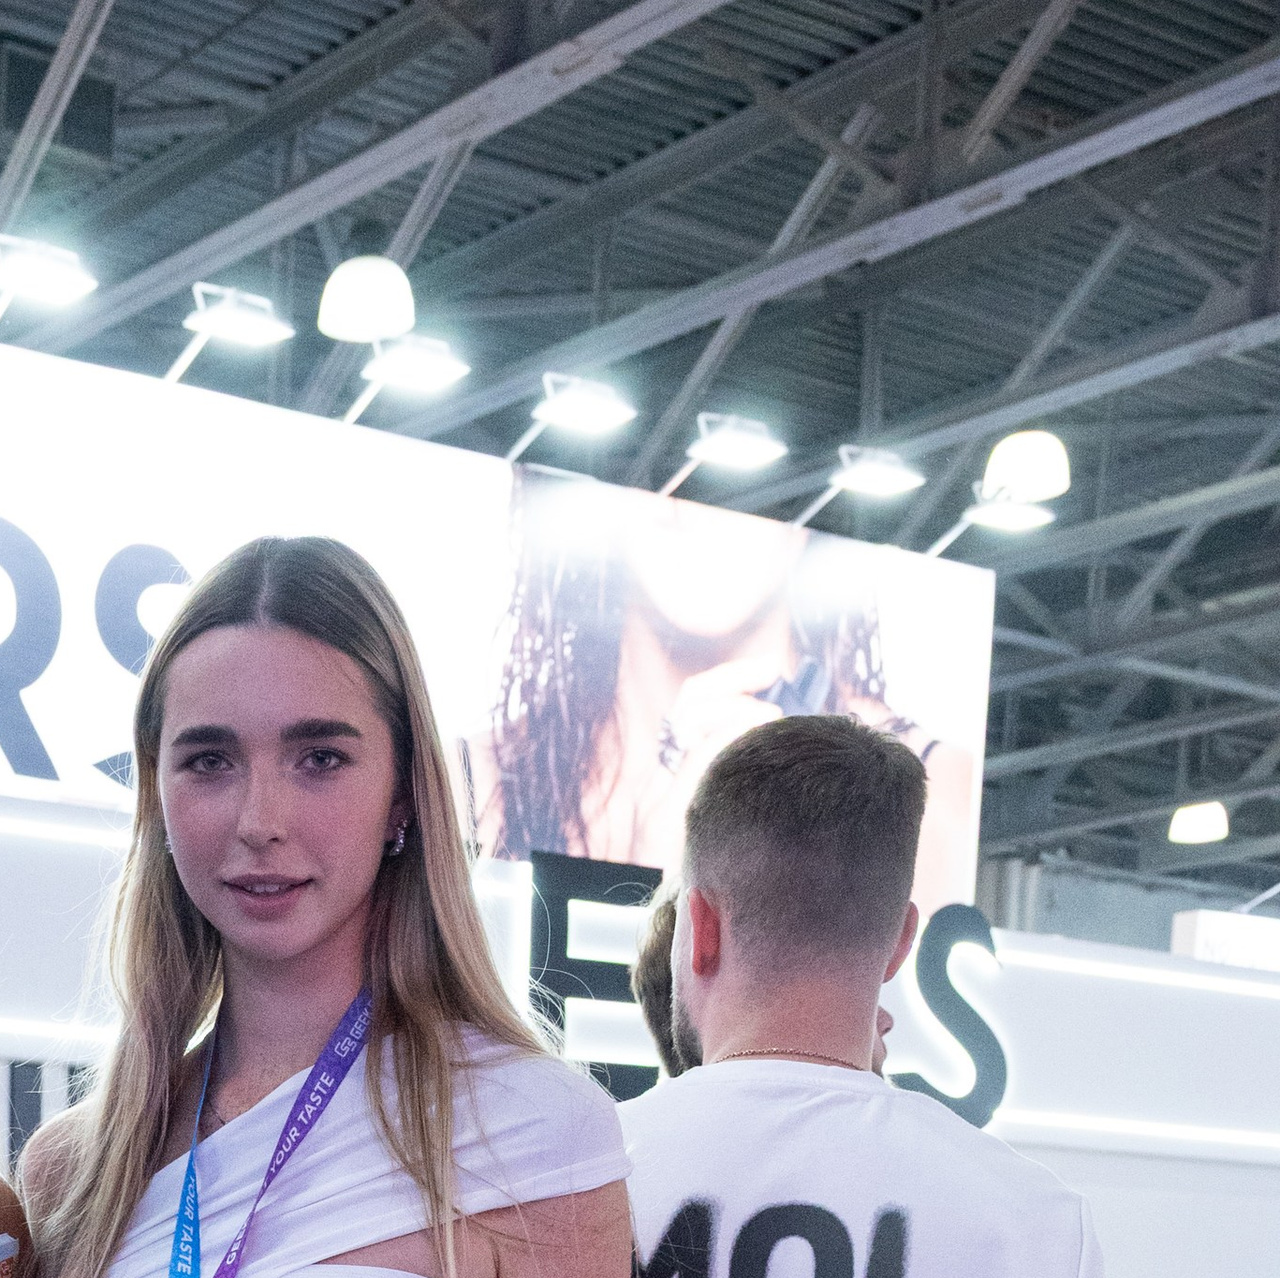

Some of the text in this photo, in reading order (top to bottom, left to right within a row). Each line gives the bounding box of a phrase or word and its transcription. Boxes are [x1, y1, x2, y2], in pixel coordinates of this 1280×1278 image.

[269, 1071, 335, 1173] YOUR TASTE
[177, 1223, 194, 1275] TASTE
